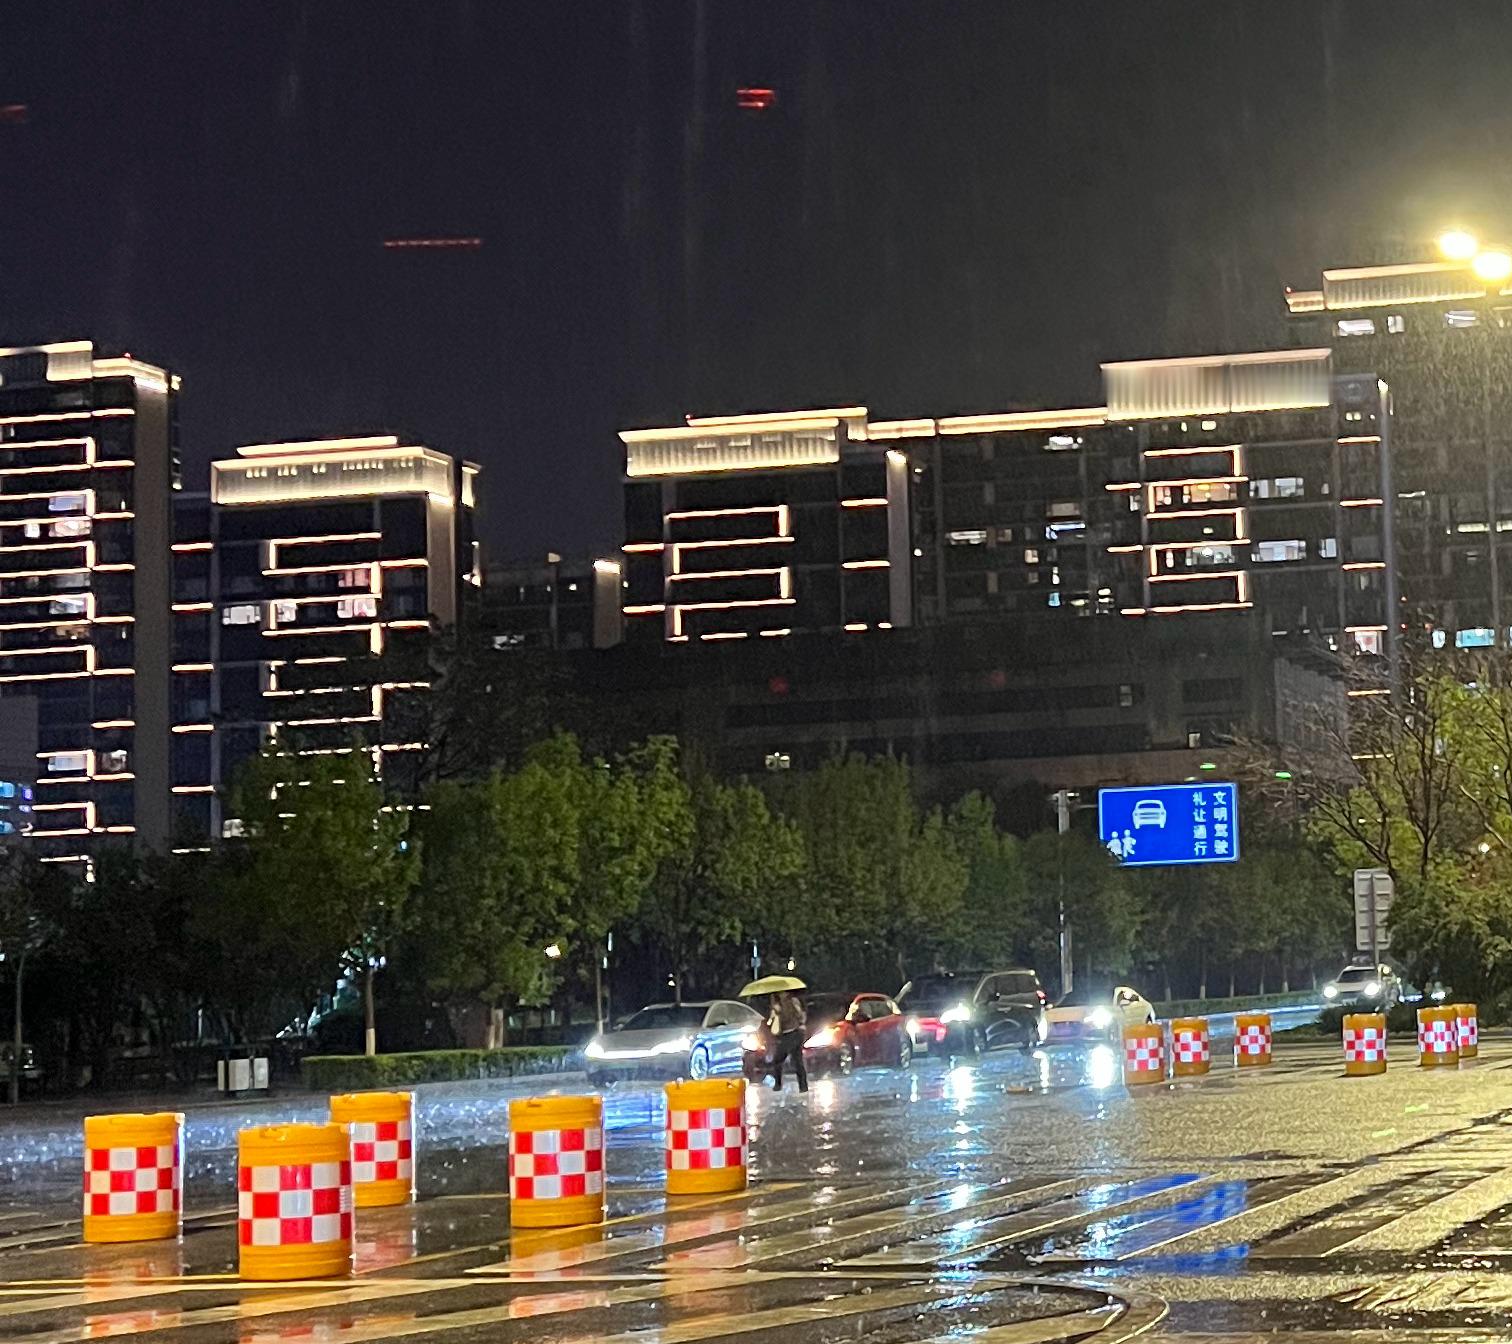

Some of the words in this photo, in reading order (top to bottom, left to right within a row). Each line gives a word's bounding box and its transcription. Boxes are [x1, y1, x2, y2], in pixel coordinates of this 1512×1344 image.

[1193, 791, 1207, 856] 礼让通行
[1213, 791, 1228, 854] 文明驾驶
